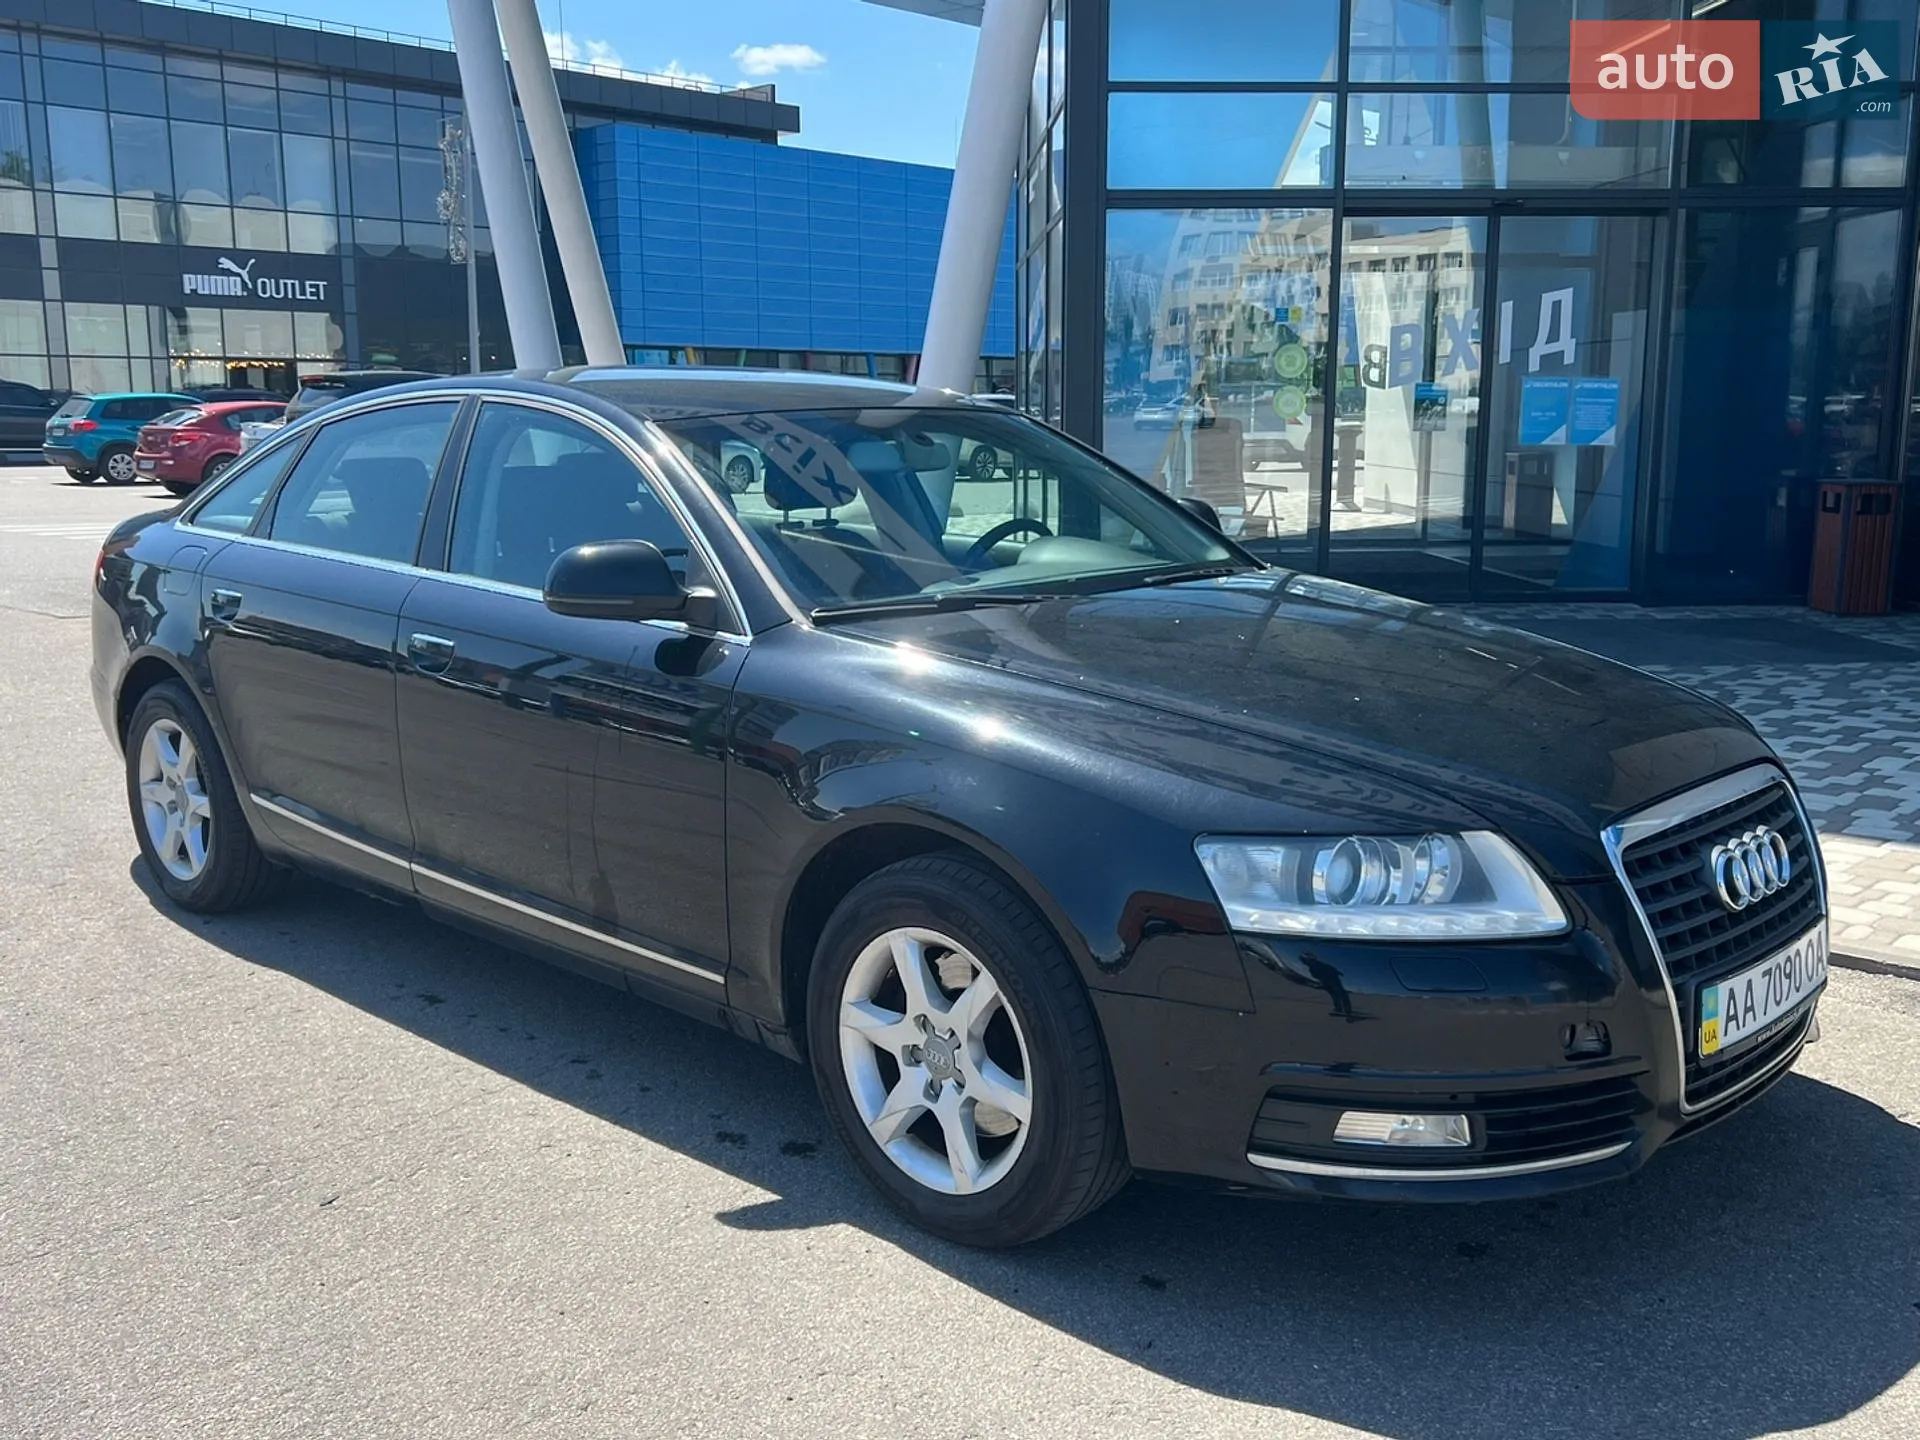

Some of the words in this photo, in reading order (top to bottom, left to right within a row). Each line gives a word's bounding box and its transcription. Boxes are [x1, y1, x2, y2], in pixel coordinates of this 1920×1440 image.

[182, 274, 243, 296] PUMA
[257, 278, 328, 300] OUTLET
[1723, 977, 1757, 1037] AA
[1761, 948, 1803, 1016] 7090
[1805, 930, 1827, 982] OA
[1703, 1029, 1717, 1044] UA
